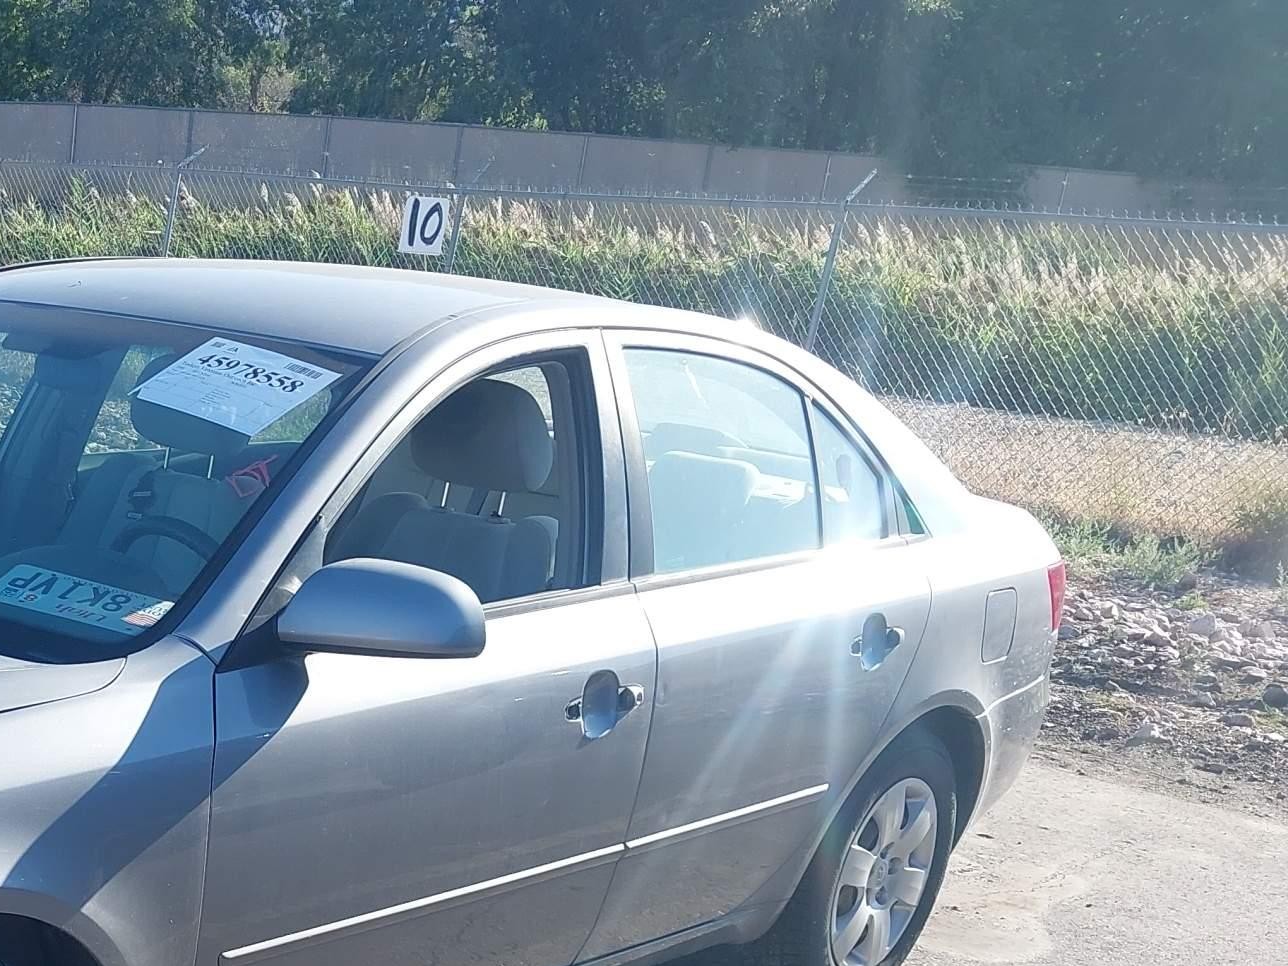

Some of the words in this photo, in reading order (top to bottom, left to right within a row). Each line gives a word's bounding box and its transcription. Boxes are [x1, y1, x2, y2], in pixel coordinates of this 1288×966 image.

[408, 198, 443, 245] 10
[198, 354, 304, 393] 45978558
[7, 572, 132, 612] 8K1VP
[55, 603, 107, 622] Utah
